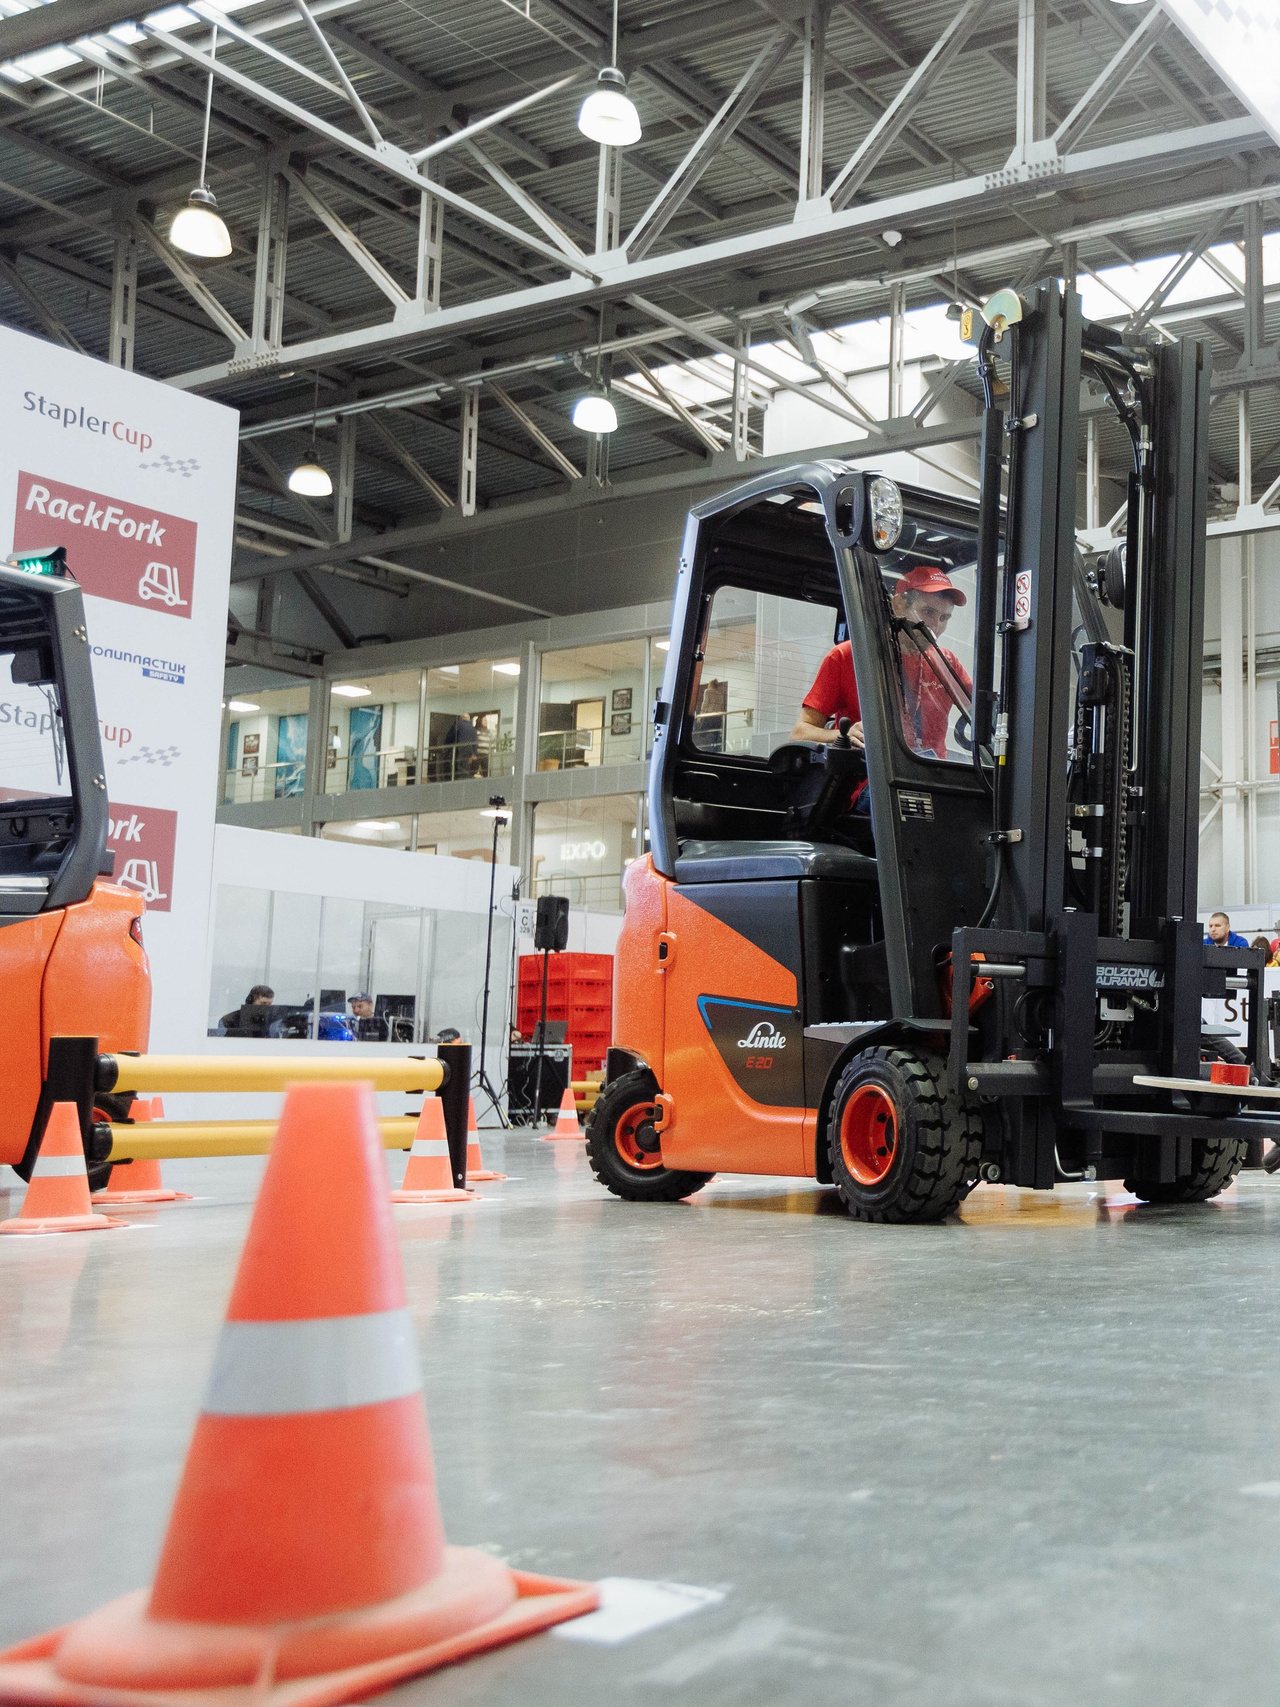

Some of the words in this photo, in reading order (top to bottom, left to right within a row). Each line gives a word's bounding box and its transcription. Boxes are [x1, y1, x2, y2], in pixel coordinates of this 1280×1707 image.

[23, 390, 153, 453] StaplerCup
[24, 483, 166, 547] RackFork
[149, 670, 179, 682] SAFETY
[0, 702, 133, 748] Stapup
[560, 840, 606, 860] EXPO
[1095, 976, 1148, 987] AURAMO
[1096, 966, 1150, 978] BOLZONI
[737, 1021, 786, 1049] Linde
